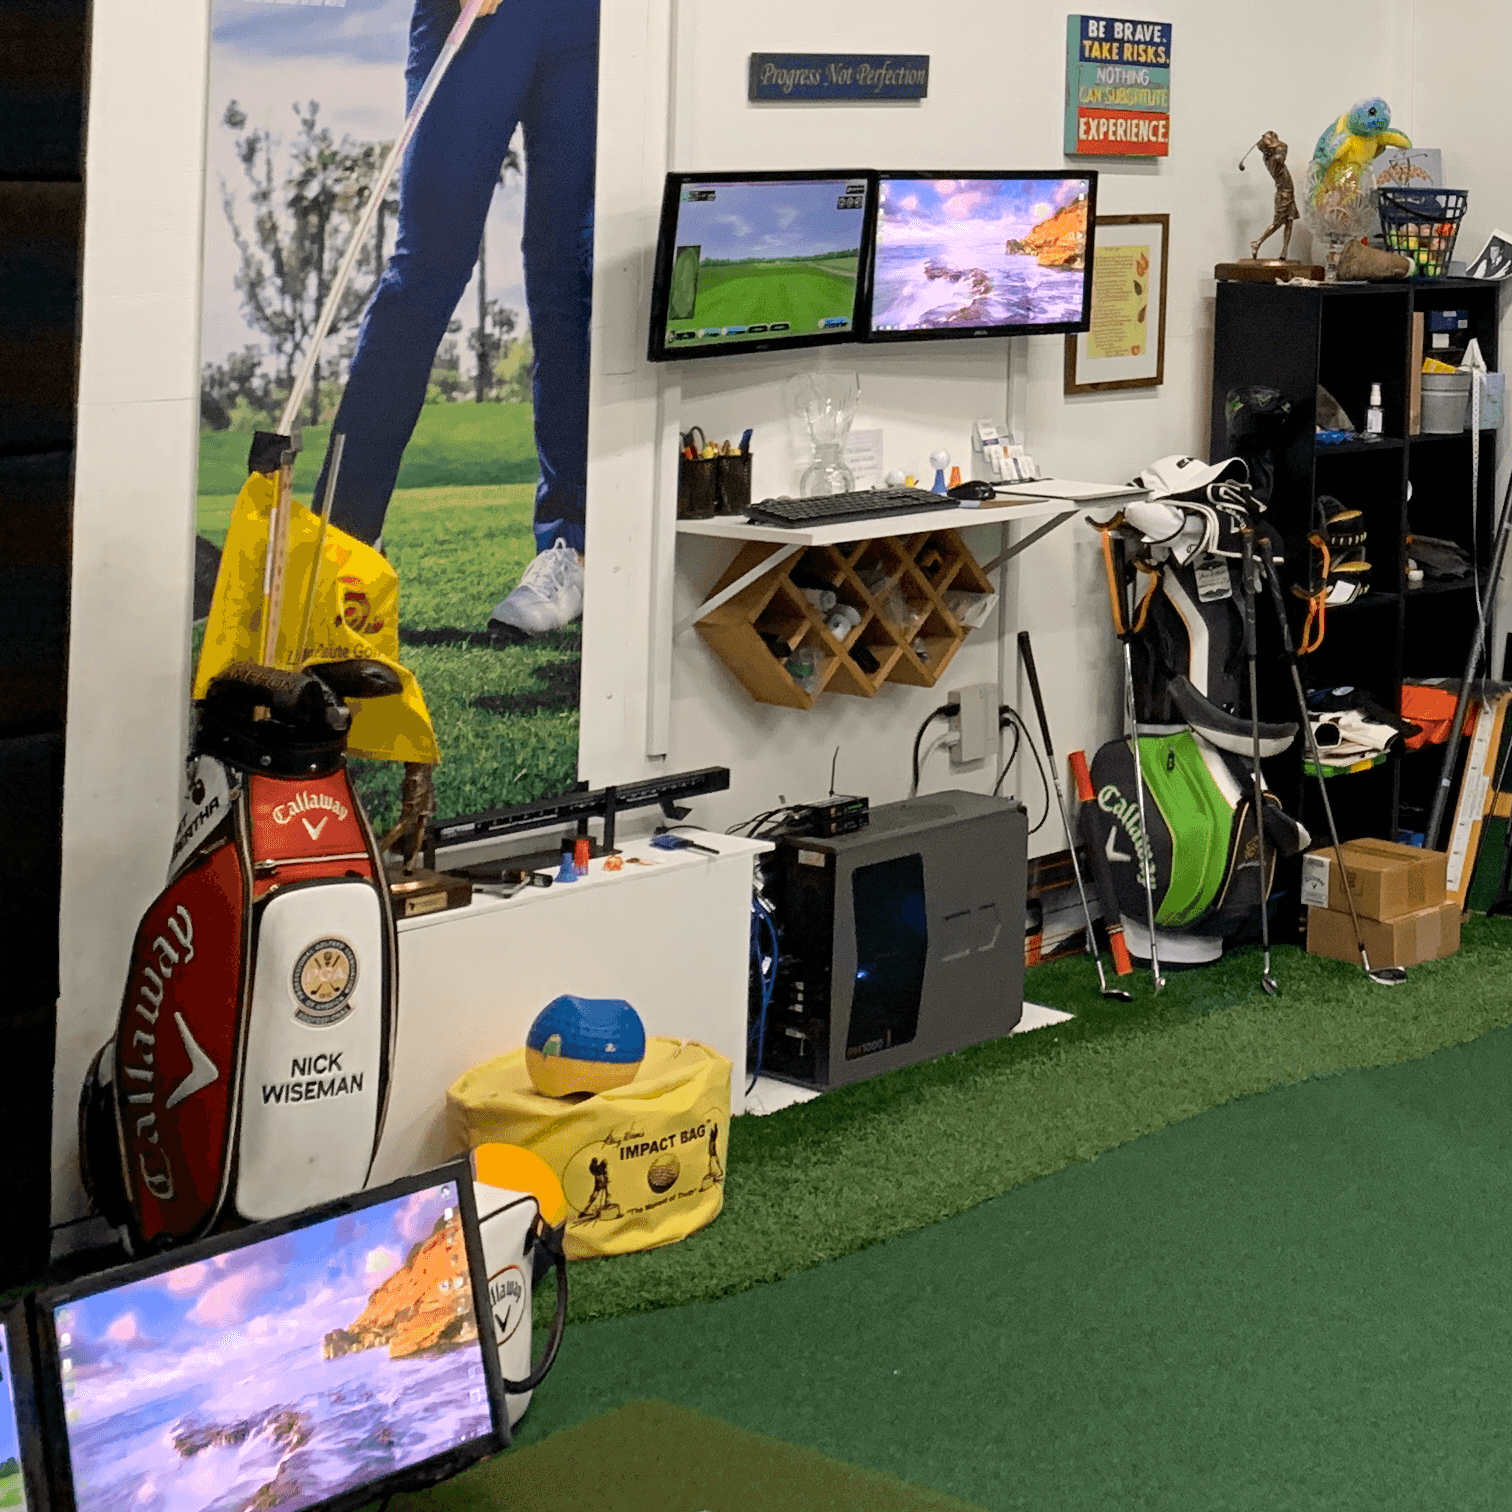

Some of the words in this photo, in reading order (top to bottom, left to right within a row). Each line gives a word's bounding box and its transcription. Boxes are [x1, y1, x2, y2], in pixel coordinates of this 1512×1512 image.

[1088, 20, 1106, 38] BE
[1114, 22, 1167, 43] BRAVE.
[1083, 40, 1119, 60] TAKE
[1123, 43, 1170, 64] RISKS.
[761, 63, 821, 94] Progress
[824, 63, 853, 86] Not
[856, 60, 926, 93] Perfection
[1097, 67, 1149, 85] NOTHING
[1079, 117, 1169, 143] EXPERIENCE.
[272, 791, 348, 825] Callaway
[305, 968, 346, 981] PGA
[126, 903, 195, 1200] Callaway
[290, 1052, 343, 1078] NICK
[262, 1072, 363, 1105] WISEMAN
[620, 1134, 677, 1160] IMPACT
[680, 1124, 706, 1144] BAG
